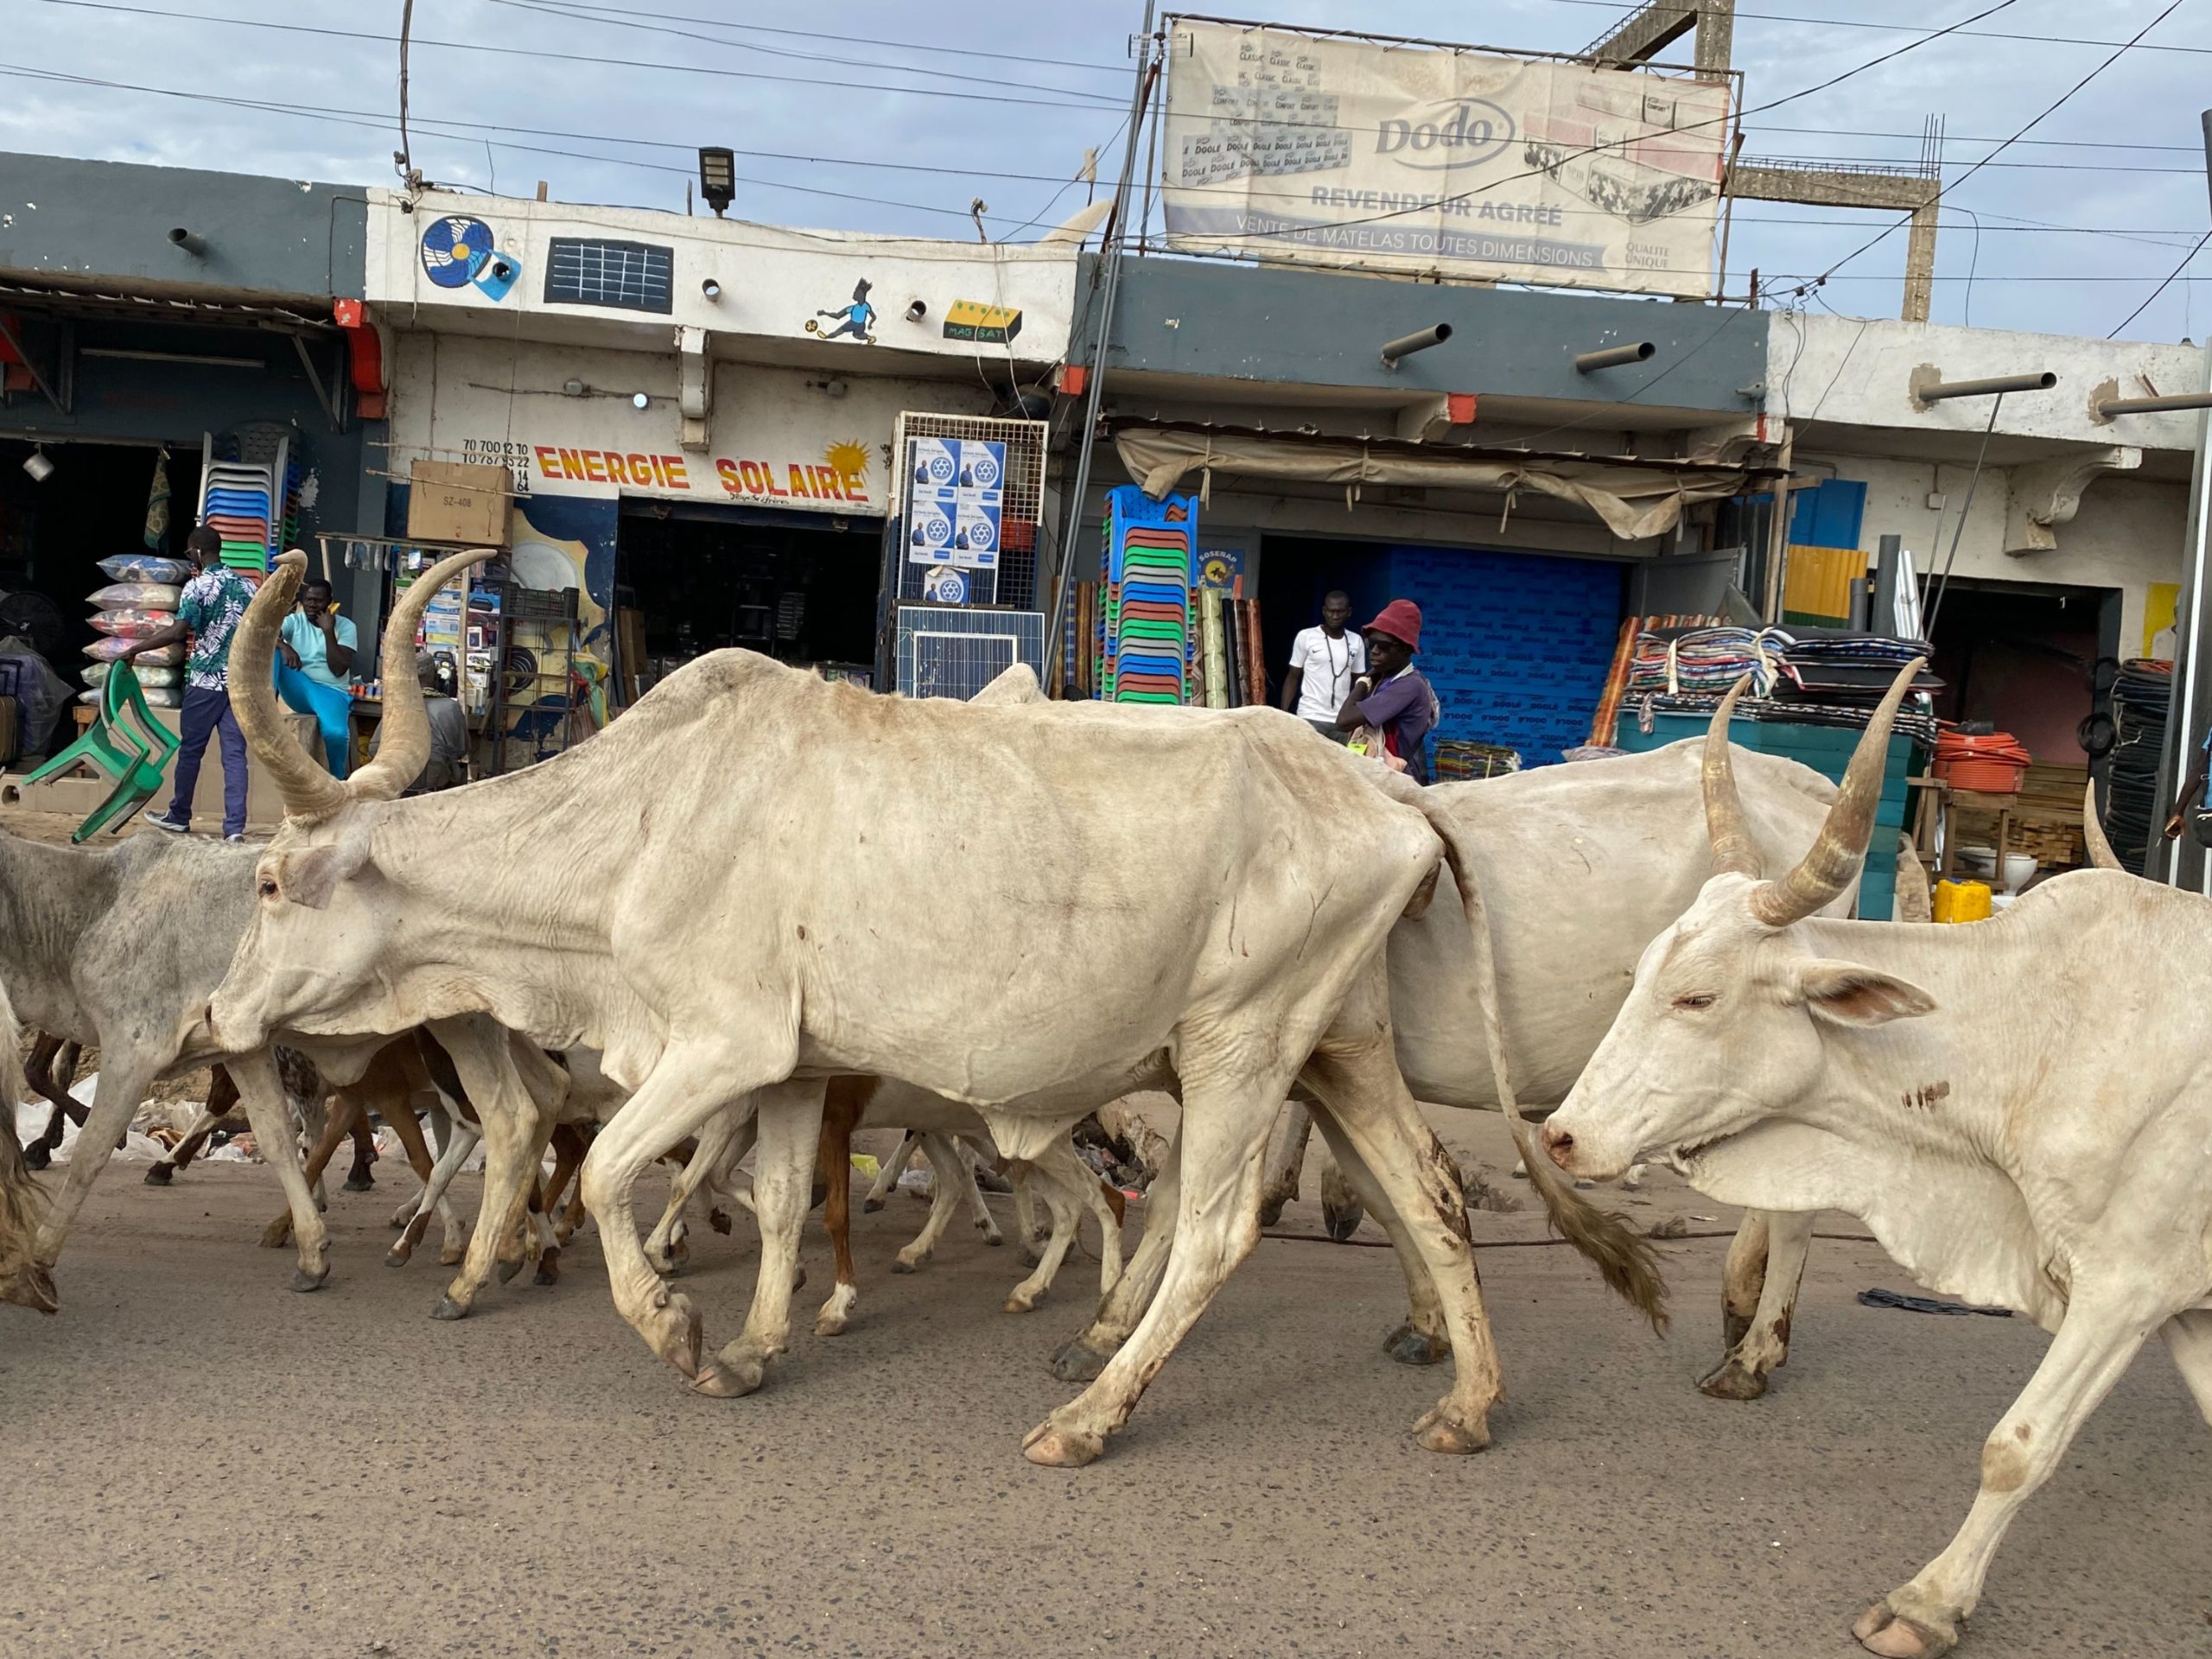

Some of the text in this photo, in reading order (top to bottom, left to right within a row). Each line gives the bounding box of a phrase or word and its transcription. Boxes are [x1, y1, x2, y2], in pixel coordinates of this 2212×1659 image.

[1376, 104, 1493, 154] Dodo
[1312, 185, 1471, 217] REVENDEUR
[1236, 214, 1593, 267] VENTE DE MATELAS TOUTES DIMENSIONS
[1624, 253, 1670, 270] UNIQUE
[463, 439, 477, 452] 70
[480, 441, 501, 454] 700
[503, 442, 514, 455] 12
[518, 456, 531, 468] 22
[534, 446, 869, 502] ENERGIE SOLAIRE
[518, 482, 530, 493] 64
[443, 496, 472, 507] SZ-408
